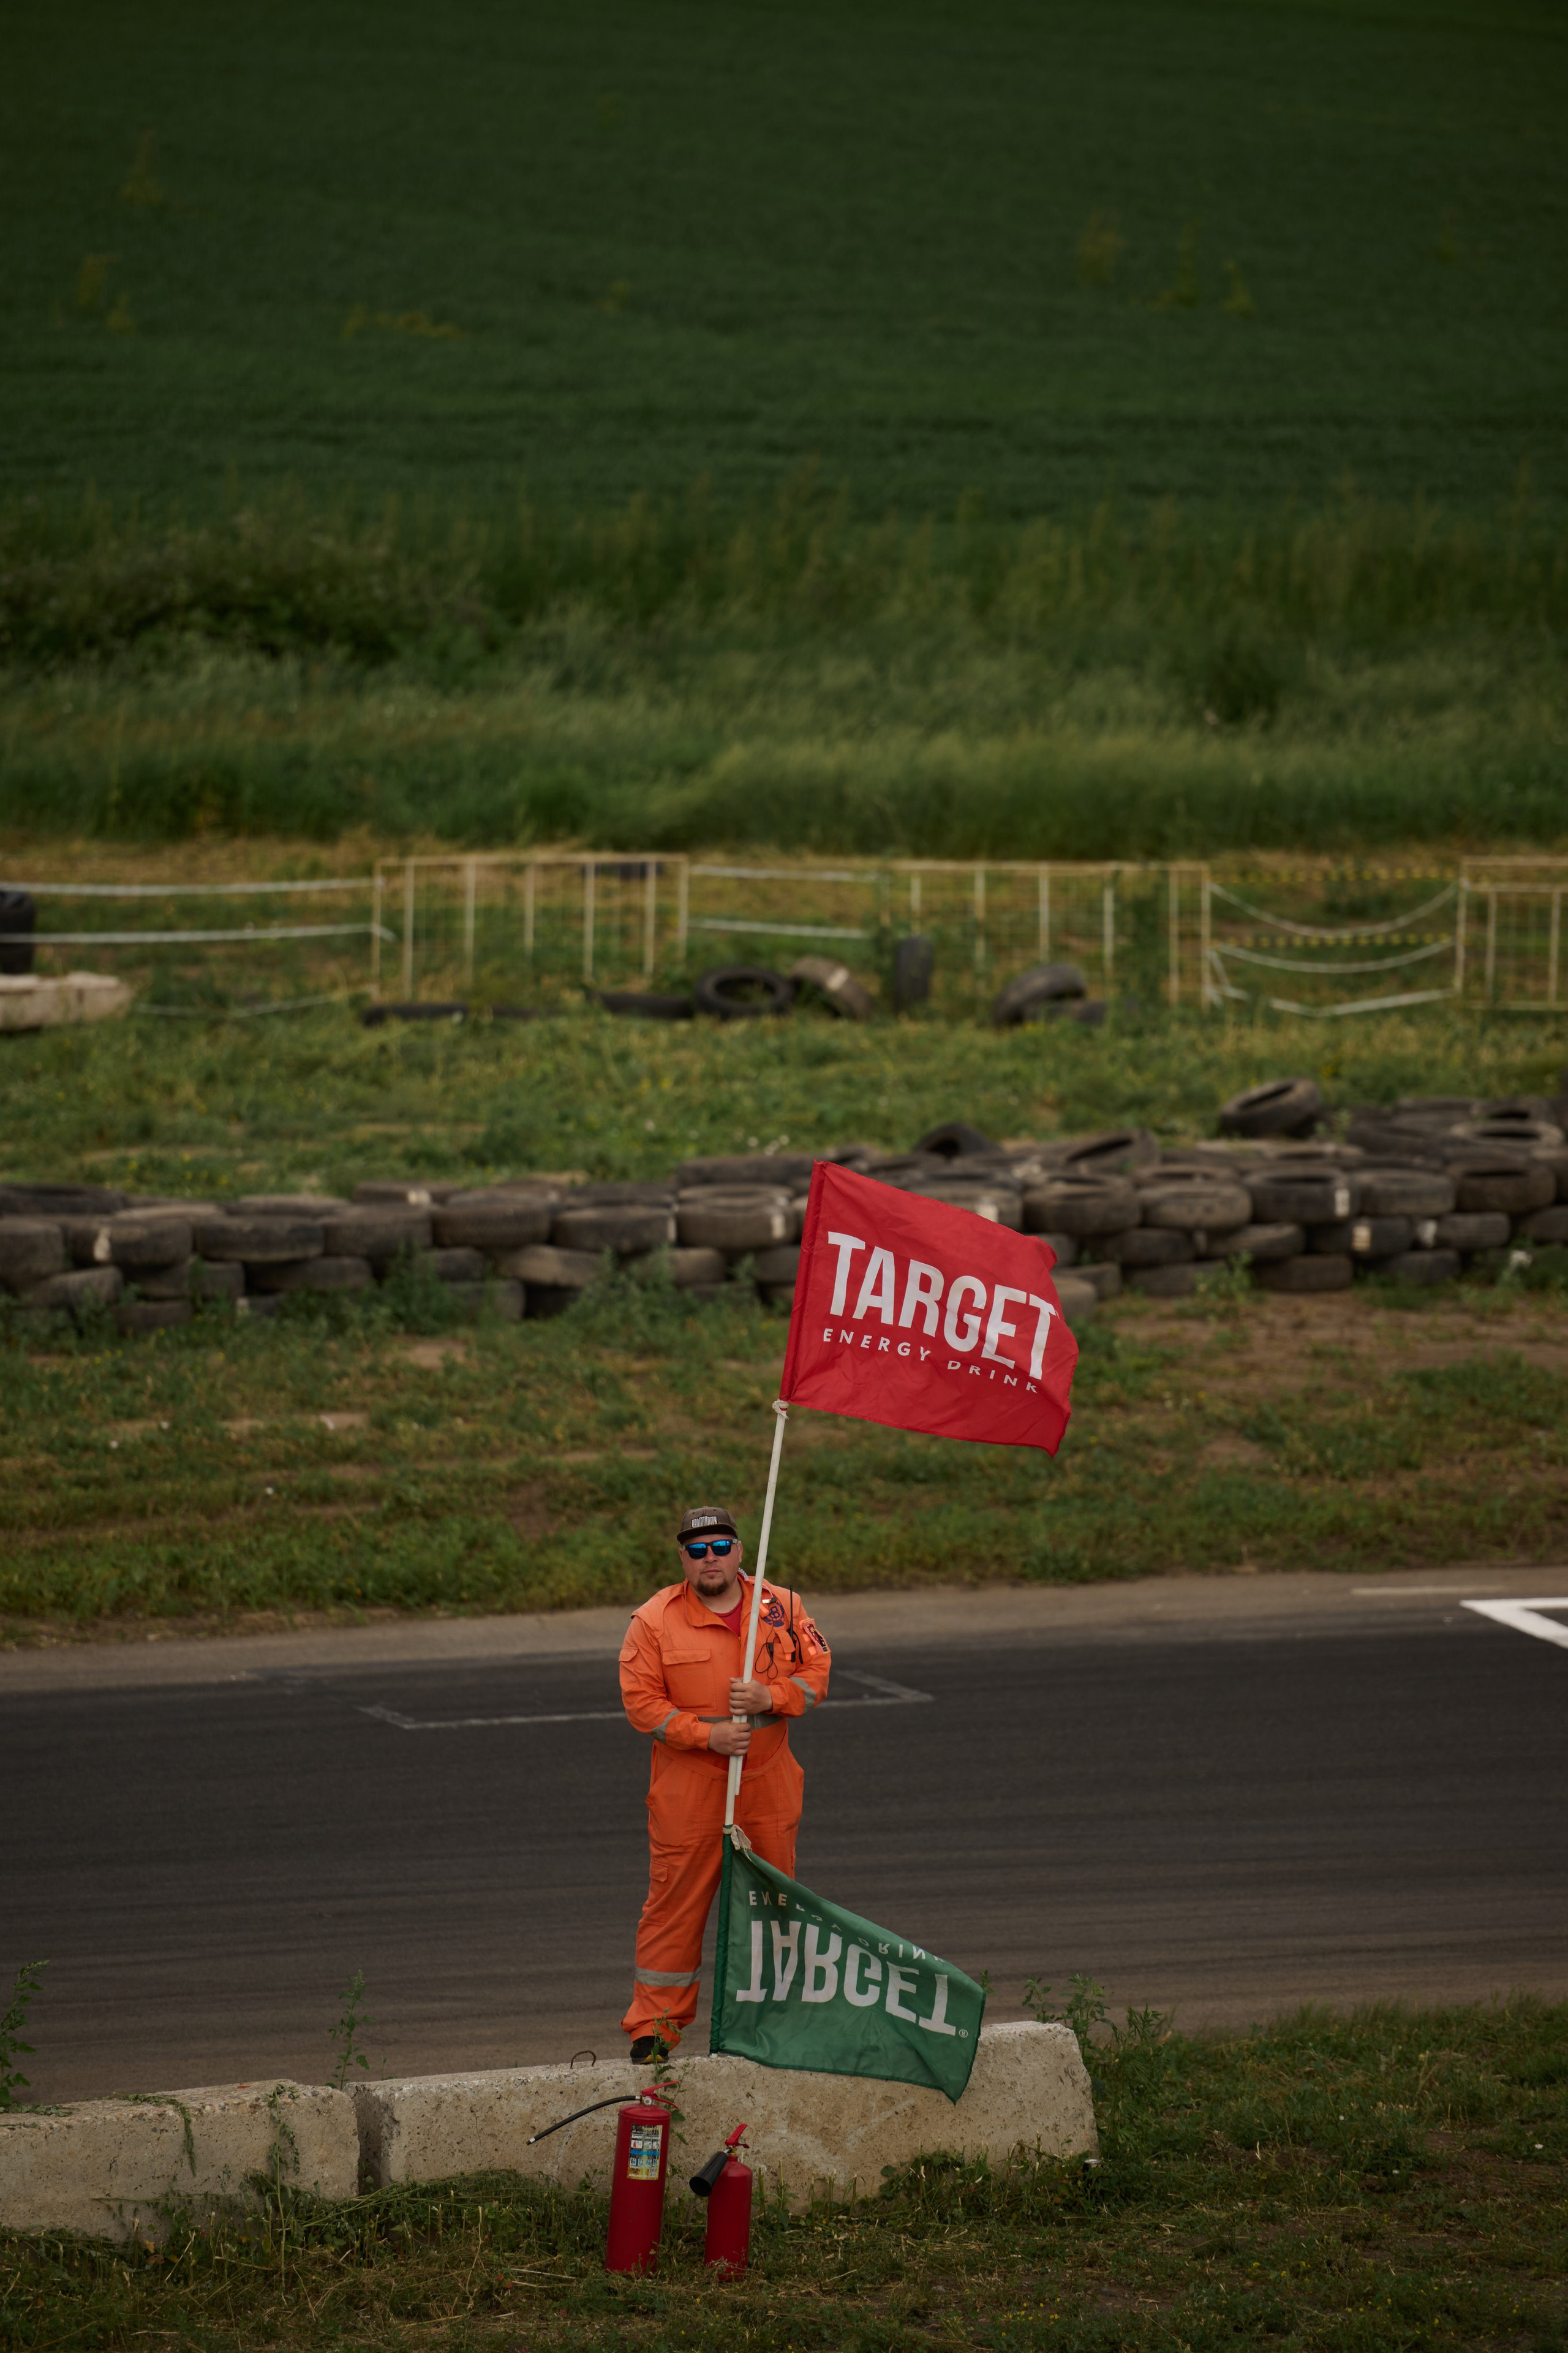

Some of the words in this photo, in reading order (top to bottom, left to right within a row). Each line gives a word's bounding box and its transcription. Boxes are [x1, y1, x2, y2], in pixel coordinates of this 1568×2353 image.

[827, 1231, 1057, 1380] TARGET
[823, 1328, 932, 1362] ENERGY
[947, 1360, 1039, 1394] DRINK
